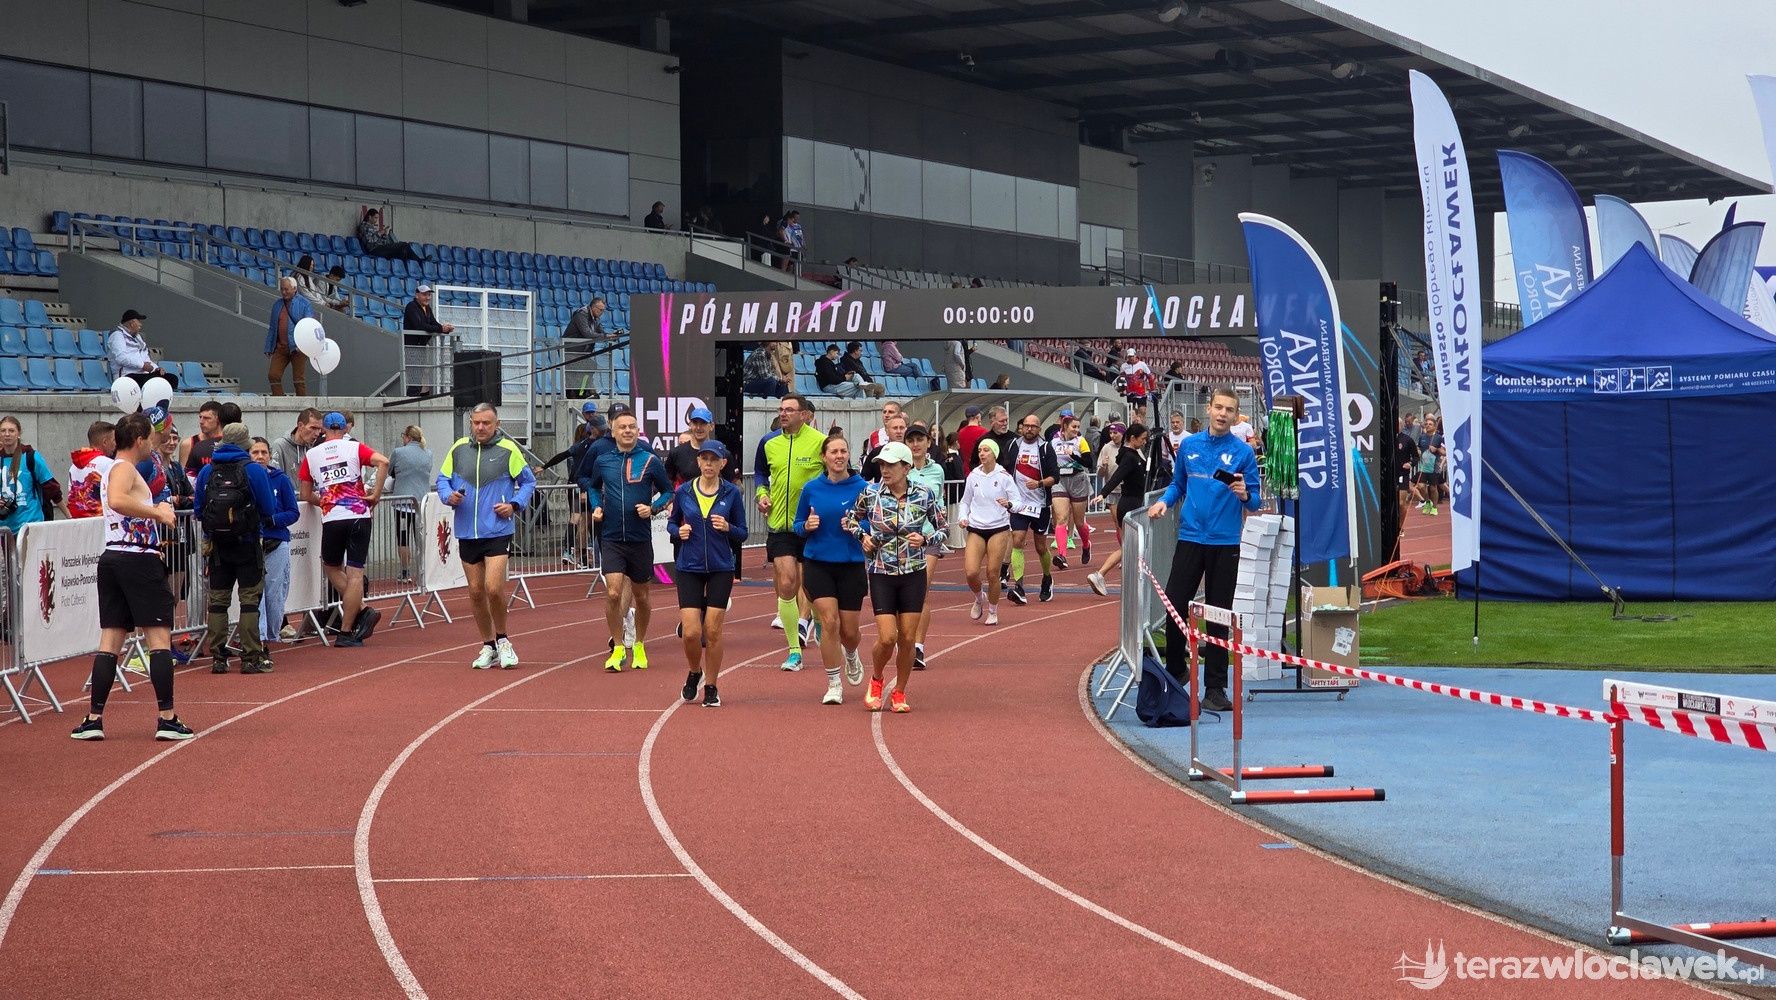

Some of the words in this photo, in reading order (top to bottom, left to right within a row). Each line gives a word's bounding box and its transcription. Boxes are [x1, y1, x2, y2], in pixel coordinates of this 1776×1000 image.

[679, 297, 887, 335] PÓŁMARATON
[943, 306, 1034, 324] 00:00:00
[1495, 374, 1588, 388] domtel-sport.pl
[1679, 374, 1712, 382] SYSTEMY
[1714, 372, 1749, 380] POMIARU
[1752, 370, 1776, 378] CZASU
[323, 467, 347, 480] 2:00
